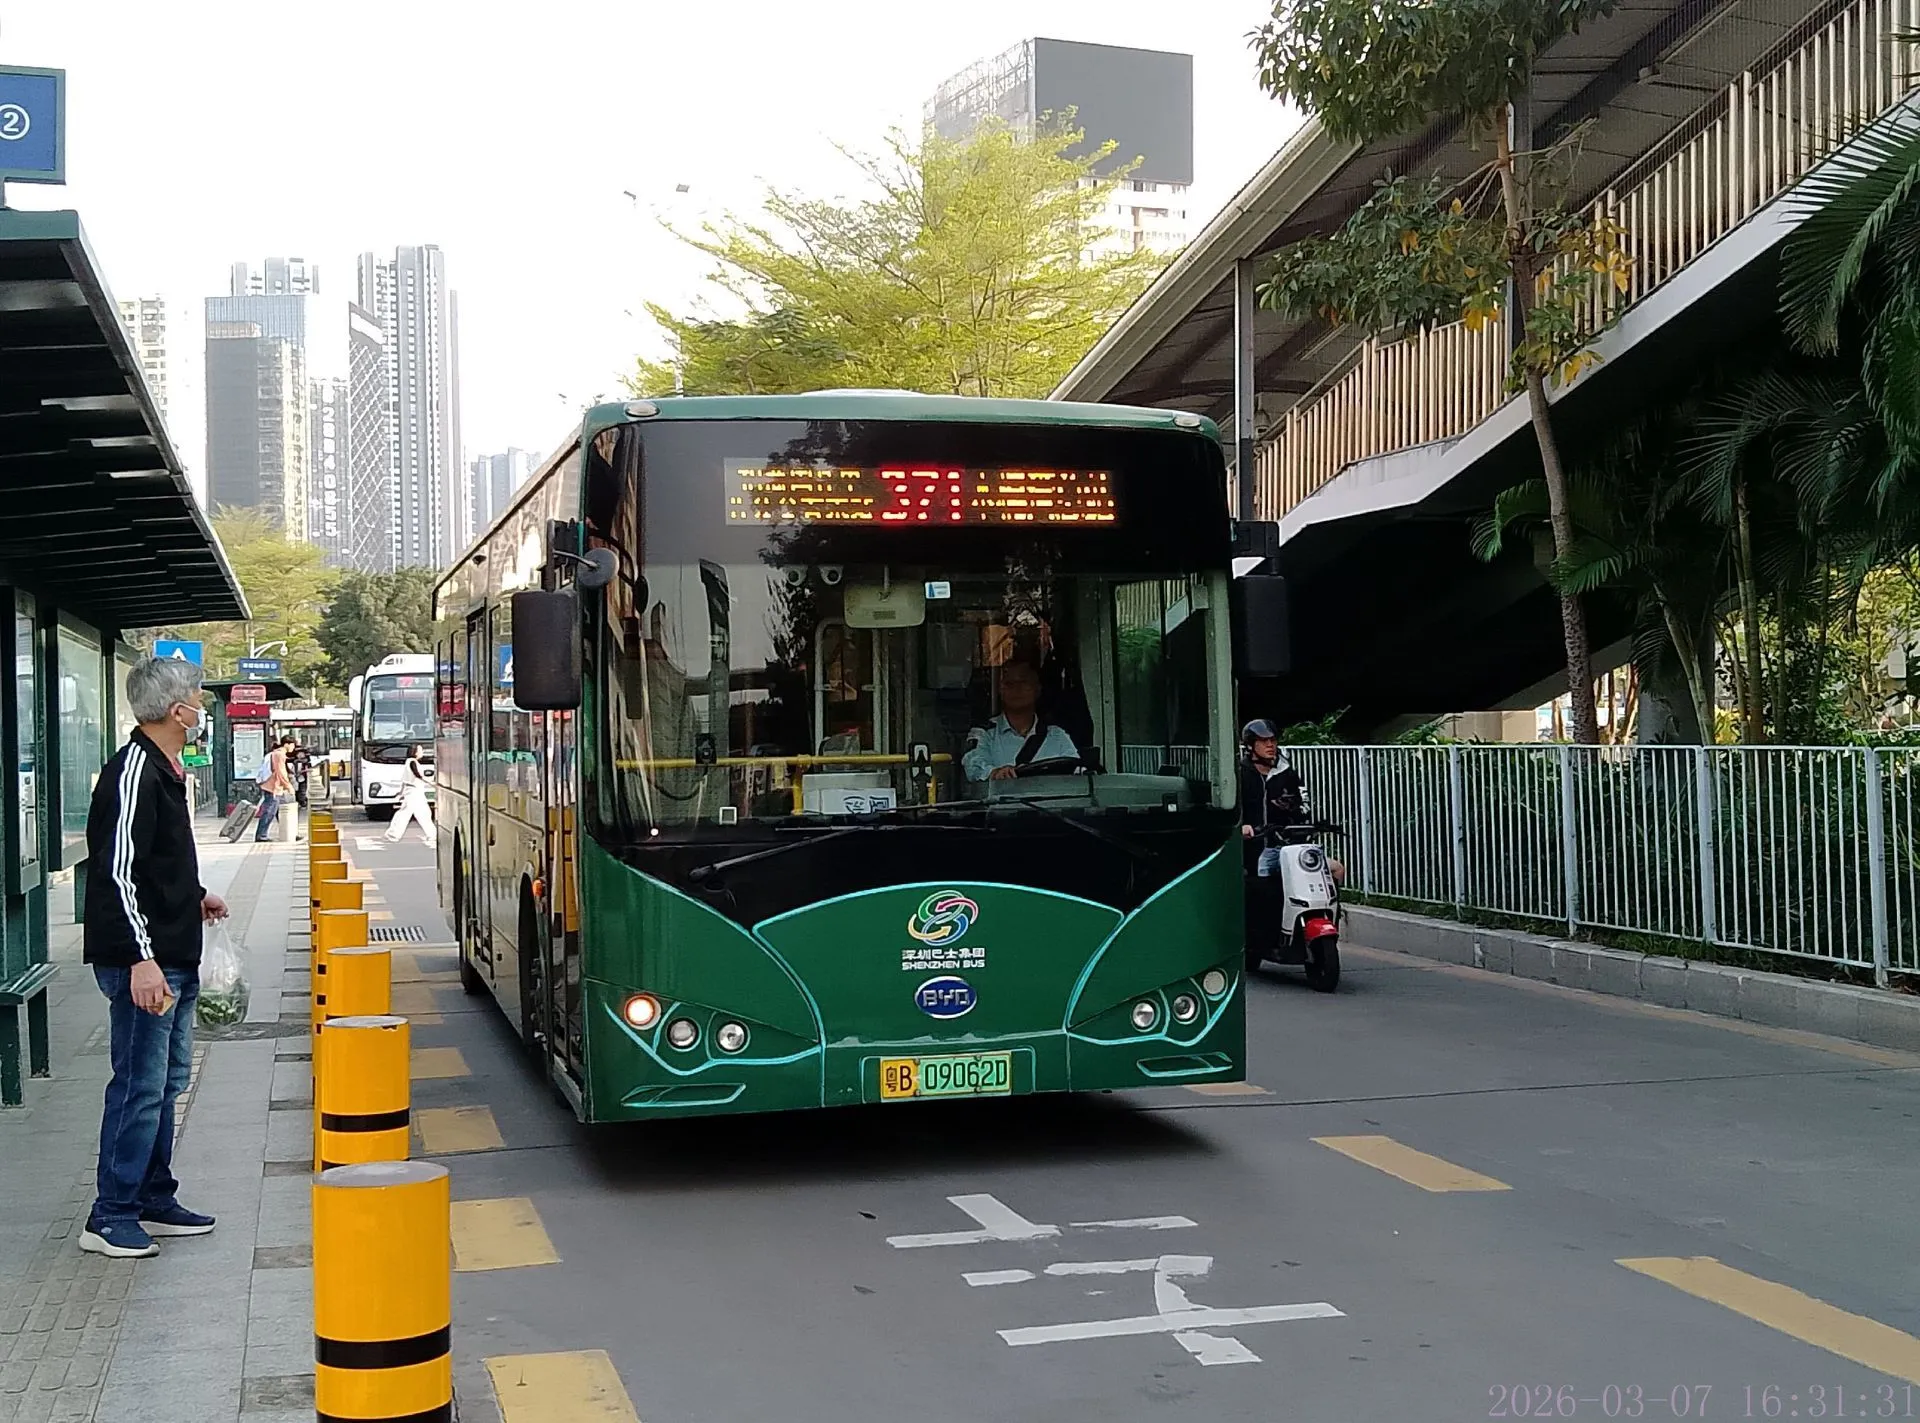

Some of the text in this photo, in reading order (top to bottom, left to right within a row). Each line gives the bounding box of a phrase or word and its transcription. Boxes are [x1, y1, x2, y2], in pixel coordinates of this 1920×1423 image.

[881, 470, 961, 521] 371
[902, 948, 985, 960] 深圳巴士集团
[902, 960, 985, 970] SHENZHEN BUS
[922, 989, 970, 1006] BYD
